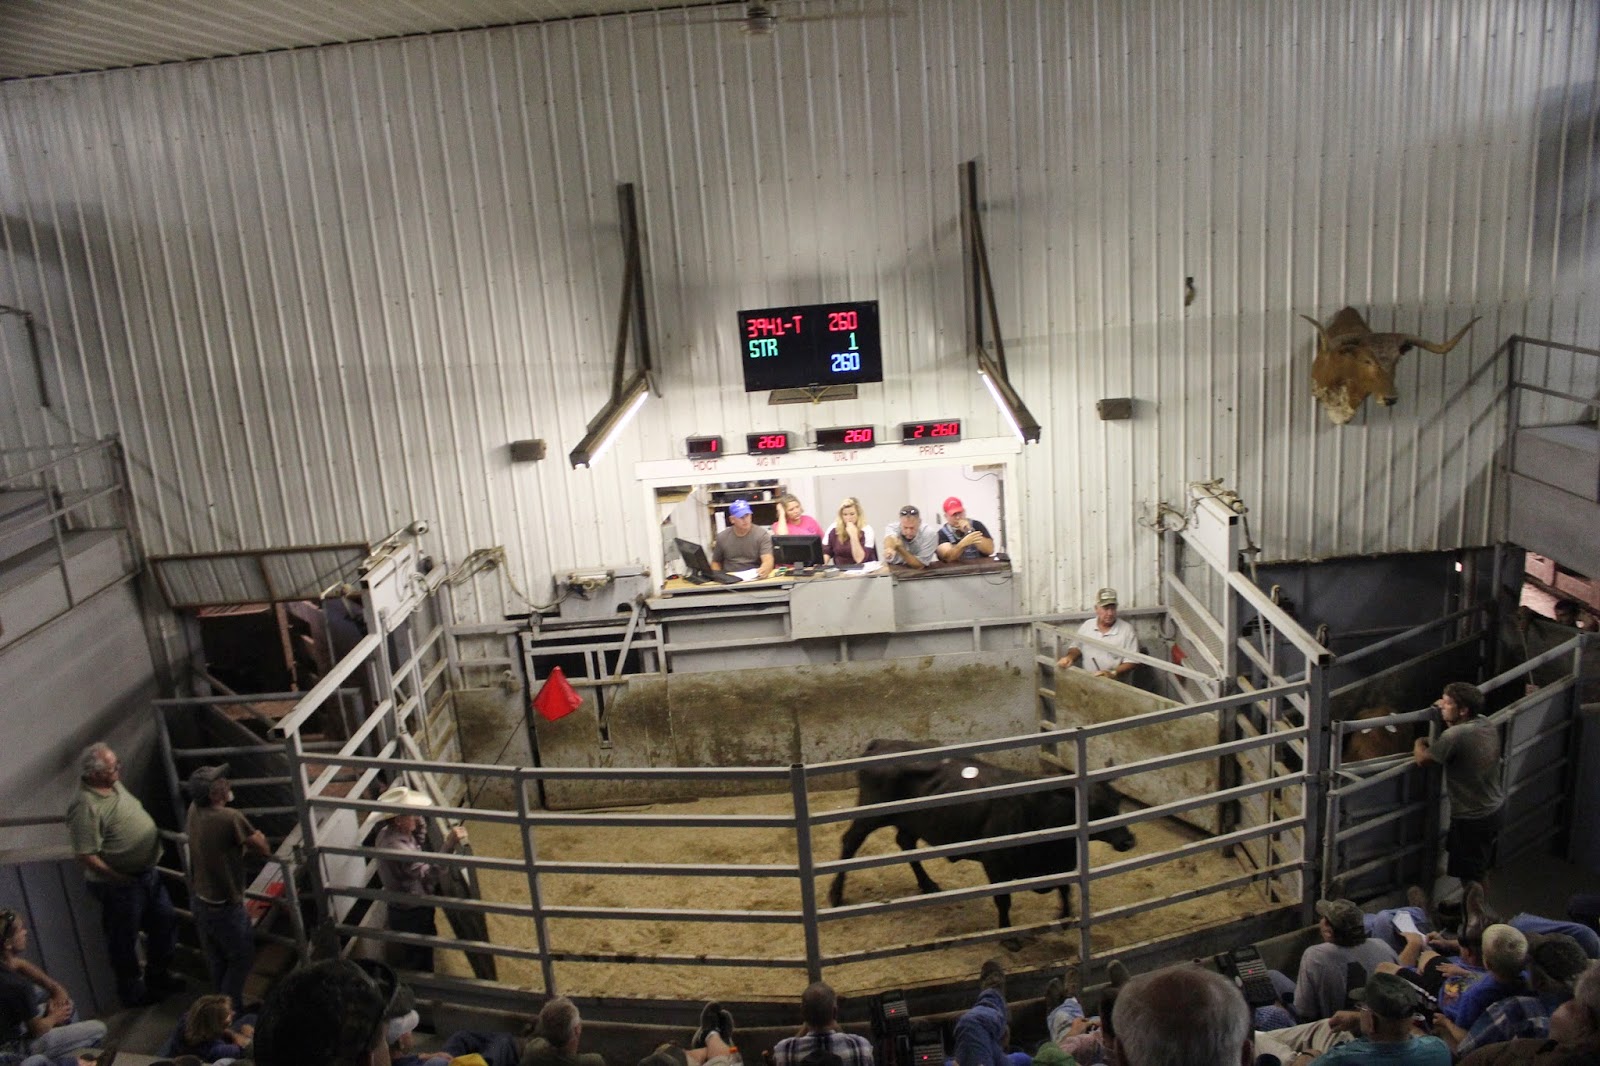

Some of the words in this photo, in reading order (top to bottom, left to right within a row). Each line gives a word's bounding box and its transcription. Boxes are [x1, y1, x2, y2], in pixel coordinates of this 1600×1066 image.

[746, 315, 803, 338] 3941-T
[827, 311, 858, 332] 260
[748, 338, 779, 358] STR
[848, 332, 859, 350] 1
[830, 352, 861, 372] 260
[844, 429, 873, 443] 260
[913, 425, 924, 438] 2
[711, 439, 717, 452] 1
[758, 435, 786, 449] 260
[919, 445, 945, 456] PRICE
